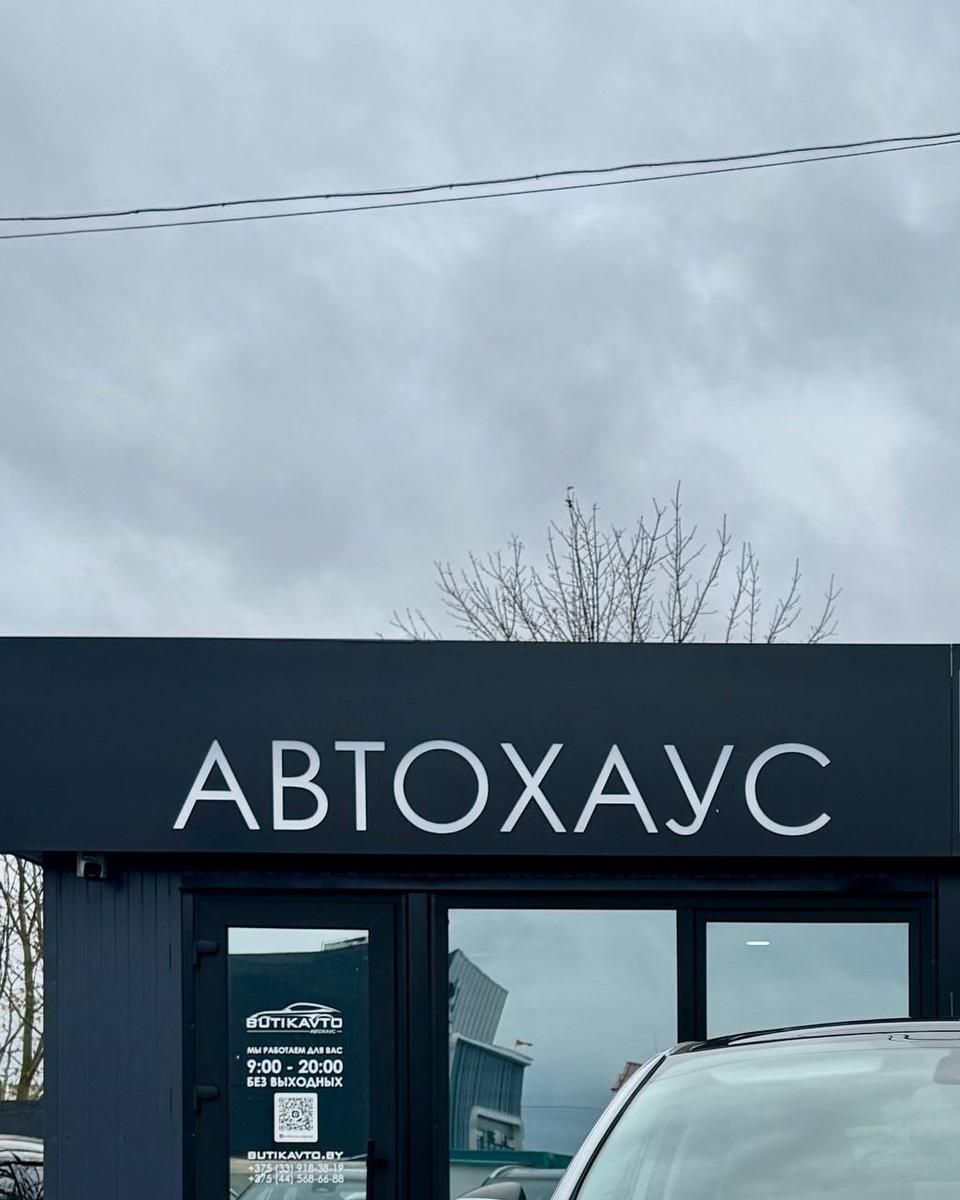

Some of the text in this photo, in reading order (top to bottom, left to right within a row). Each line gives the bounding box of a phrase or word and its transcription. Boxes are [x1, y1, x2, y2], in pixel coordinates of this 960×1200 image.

[173, 739, 832, 836] АВТОХАУС
[246, 1017, 343, 1029] BUTIKAVTO
[247, 1046, 344, 1055] МЫ РАБОТАЕМ ДЛЯ ВАС
[247, 1059, 282, 1074] 9:00
[298, 1059, 344, 1074] 20:00
[246, 1077, 344, 1089] БЕЗ ВЫХОДНЫХ
[247, 1151, 344, 1160] BUTIKAVTO.BY
[275, 1174, 294, 1186] (44)
[297, 1174, 345, 1184] 568-66-88
